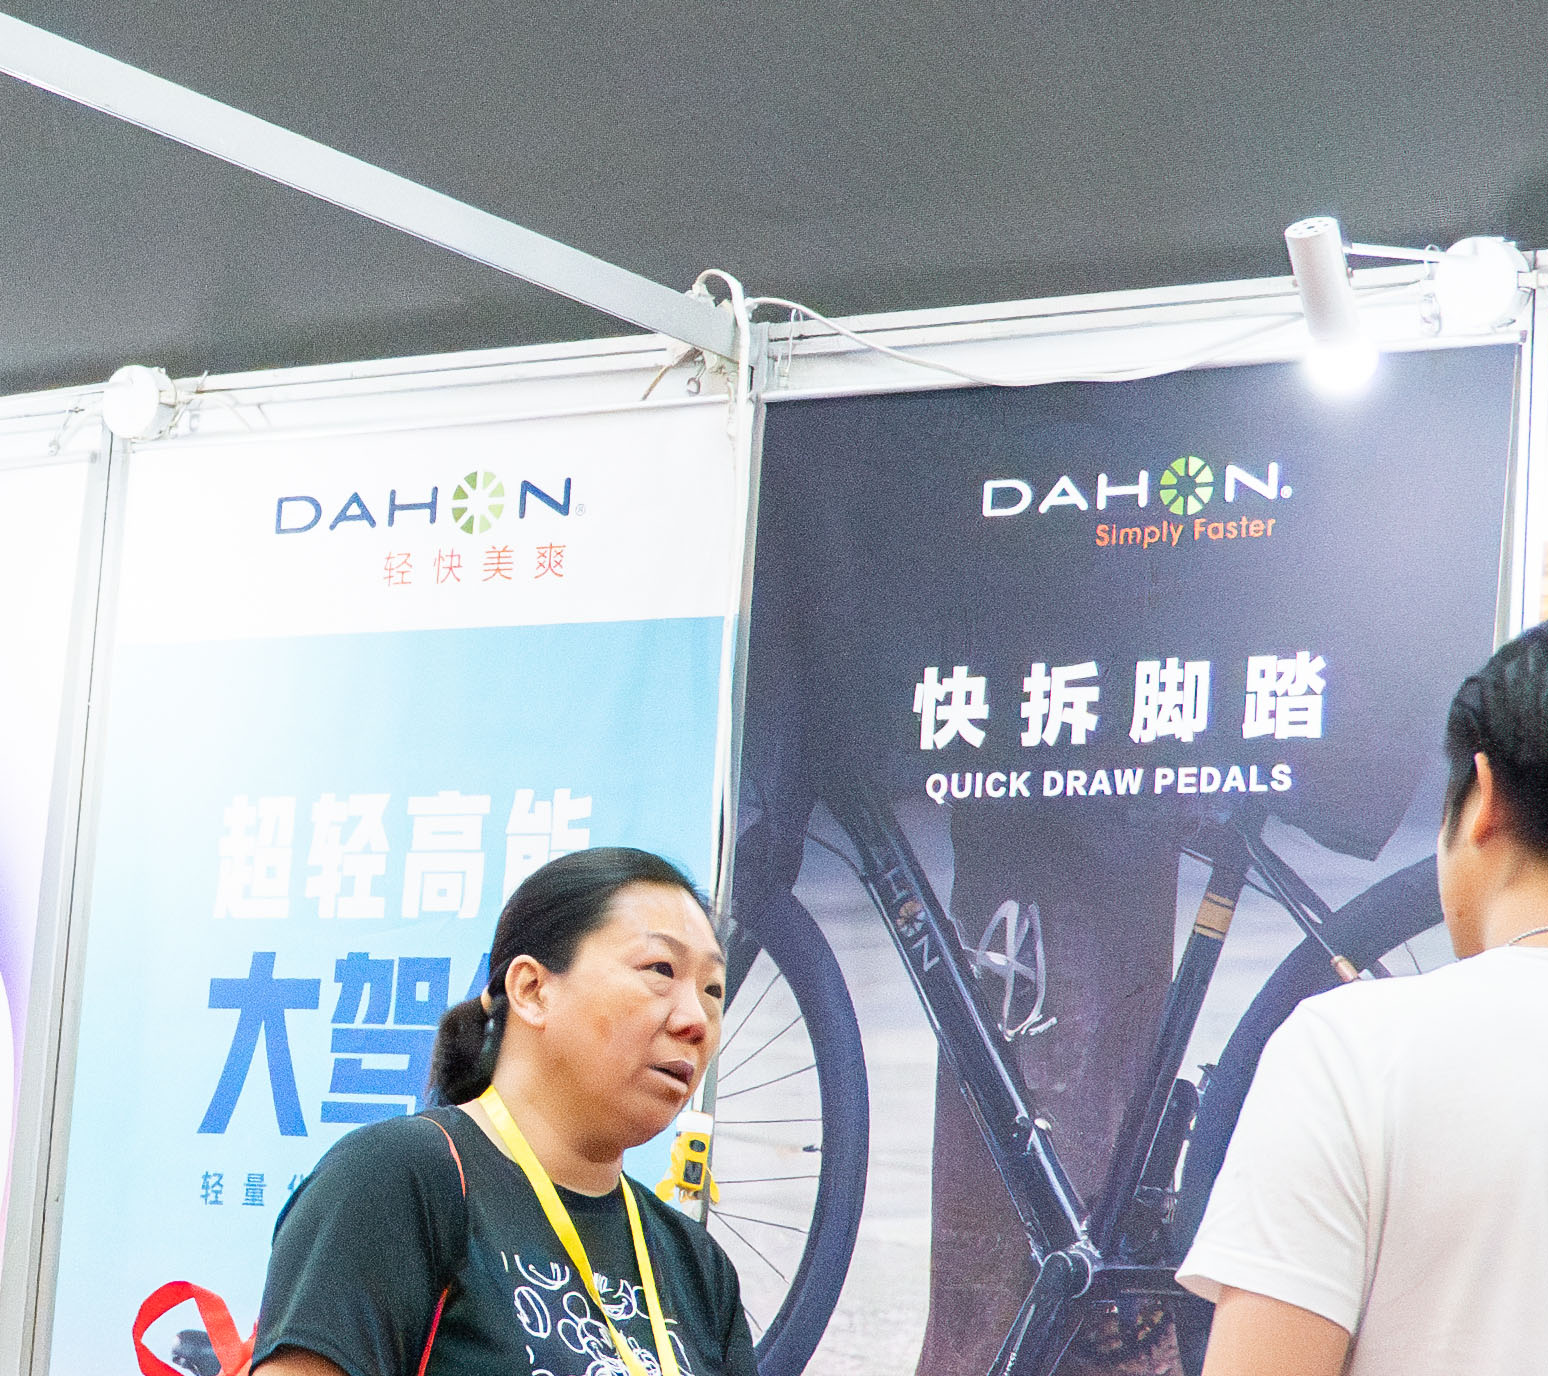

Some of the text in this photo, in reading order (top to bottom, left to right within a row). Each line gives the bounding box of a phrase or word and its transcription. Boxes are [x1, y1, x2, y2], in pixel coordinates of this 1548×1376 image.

[275, 470, 573, 535] DAHON
[982, 455, 1280, 517] DAHON
[1096, 513, 1276, 549] Simply Faster
[382, 541, 568, 588] 轻快美爽
[913, 650, 1329, 752] 快拆脚踏
[925, 763, 1292, 804] QUICK DRAW PEDALS
[196, 950, 491, 1138] 大驾
